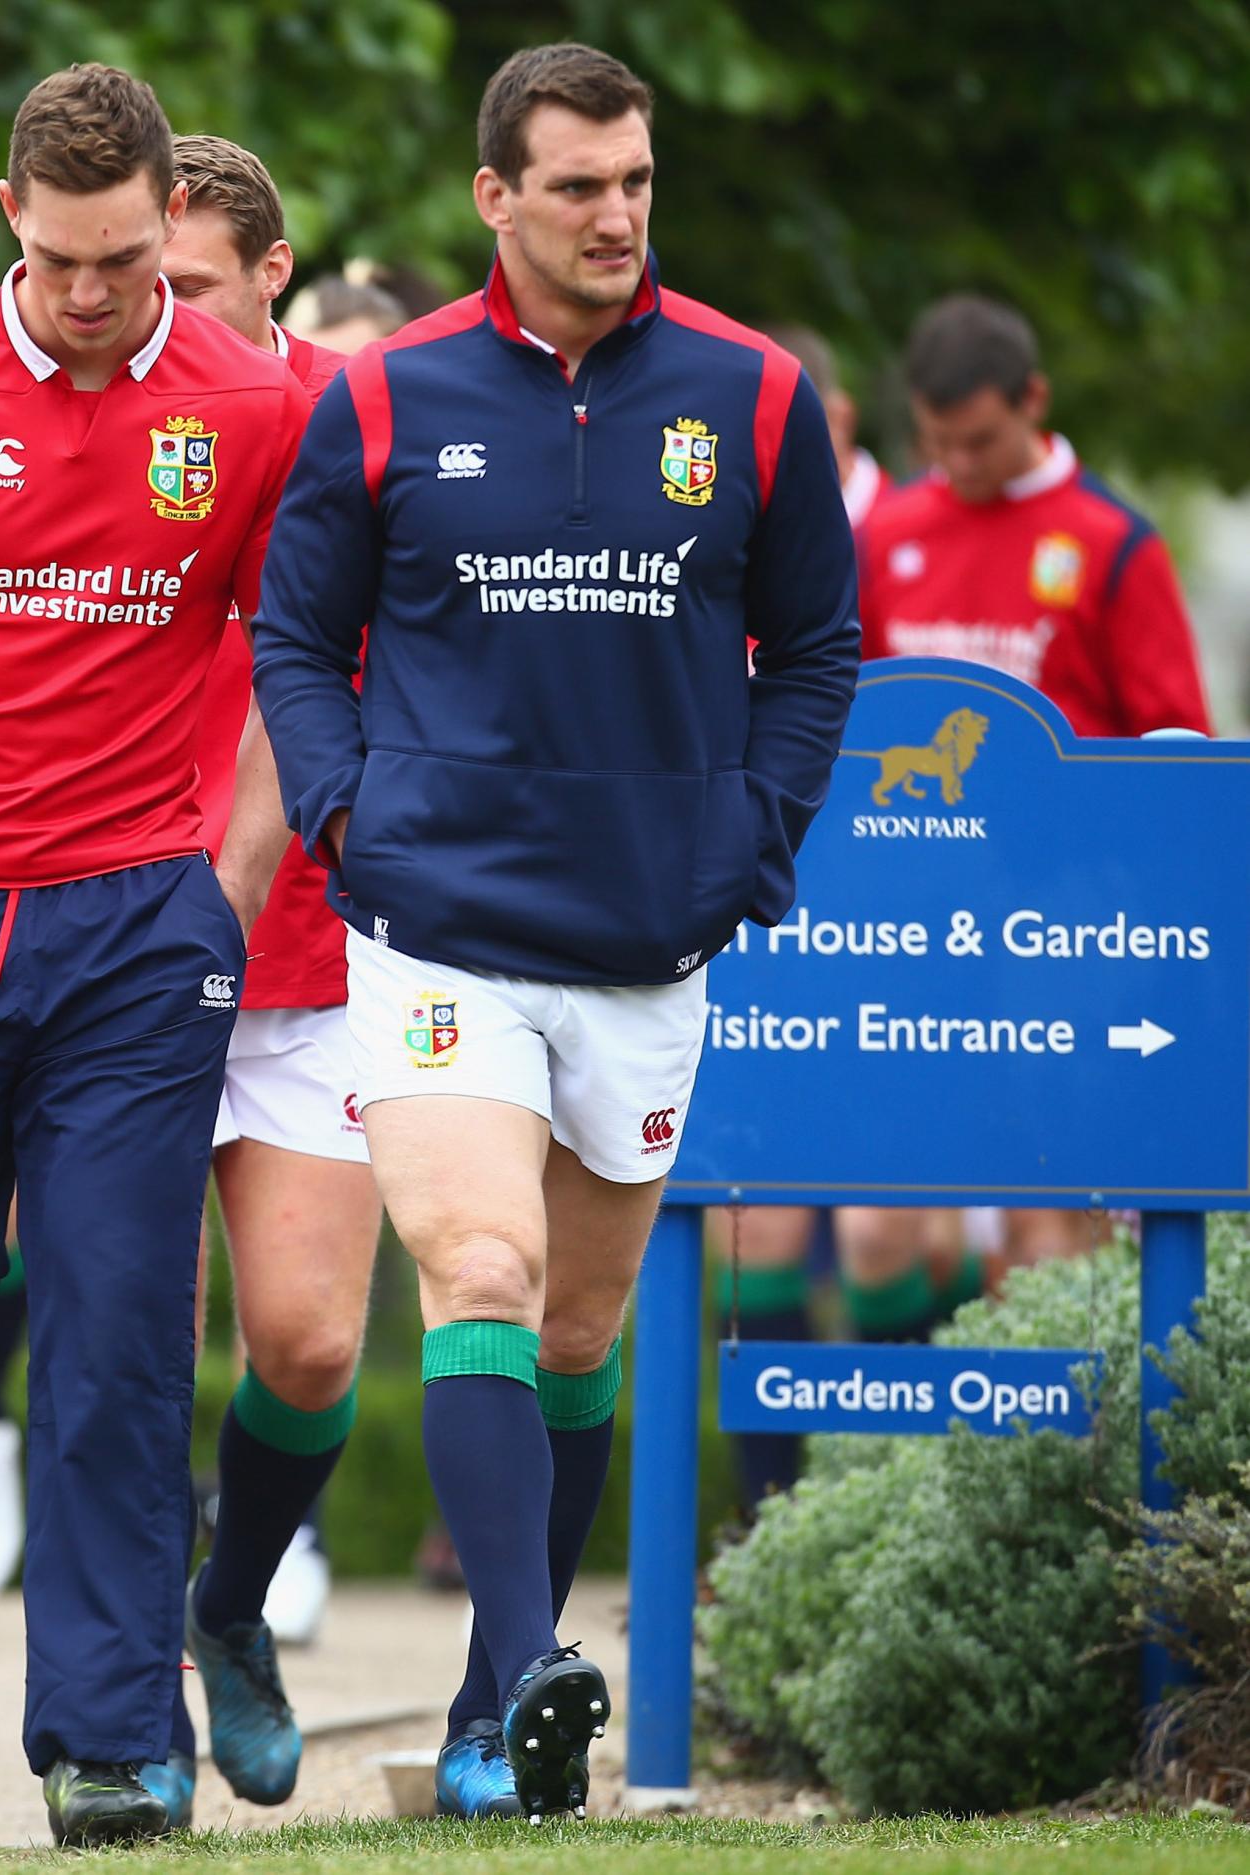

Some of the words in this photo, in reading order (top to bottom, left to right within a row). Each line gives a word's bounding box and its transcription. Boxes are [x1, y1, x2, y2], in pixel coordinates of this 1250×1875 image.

[121, 566, 182, 597] Life
[455, 548, 611, 583] Standard
[618, 550, 680, 586] Life
[479, 583, 677, 618] Investments
[852, 816, 920, 838] SYON
[924, 816, 986, 839] PARK
[373, 915, 389, 936] NZ
[767, 906, 929, 956] House
[945, 910, 983, 957] &
[1001, 910, 1211, 961] Gardens
[706, 1002, 840, 1051] isitor
[857, 1003, 1075, 1055] Entrance
[755, 1366, 935, 1413] Gardens
[949, 1371, 1070, 1426] Open
